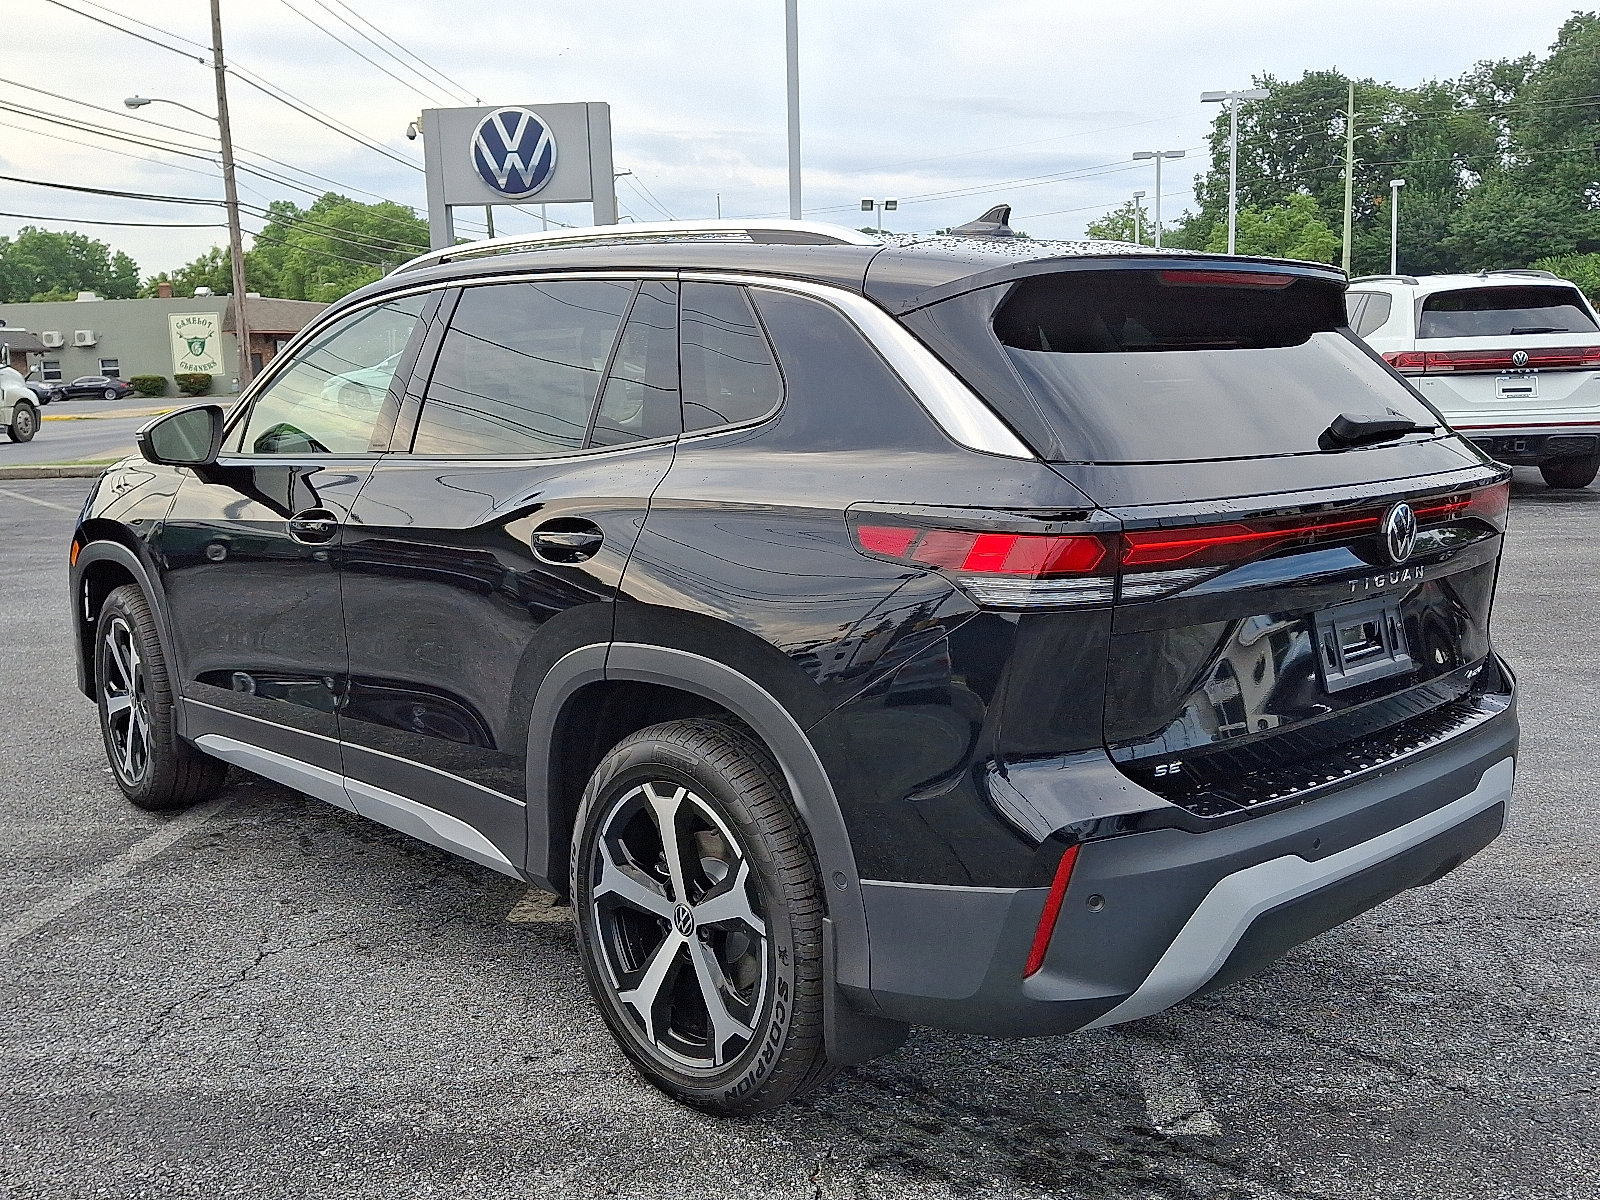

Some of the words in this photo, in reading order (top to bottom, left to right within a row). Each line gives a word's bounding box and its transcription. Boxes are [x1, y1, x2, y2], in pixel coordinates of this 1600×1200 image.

[470, 106, 557, 199] VW
[175, 317, 213, 330] CAMELOT
[180, 361, 218, 372] CLEANERS
[1512, 350, 1529, 367] VW
[1387, 502, 1417, 563] VW
[1348, 566, 1425, 592] TIGUAN
[1154, 761, 1182, 777] SE
[674, 904, 694, 937] VW
[724, 976, 789, 1100] SCORPION
